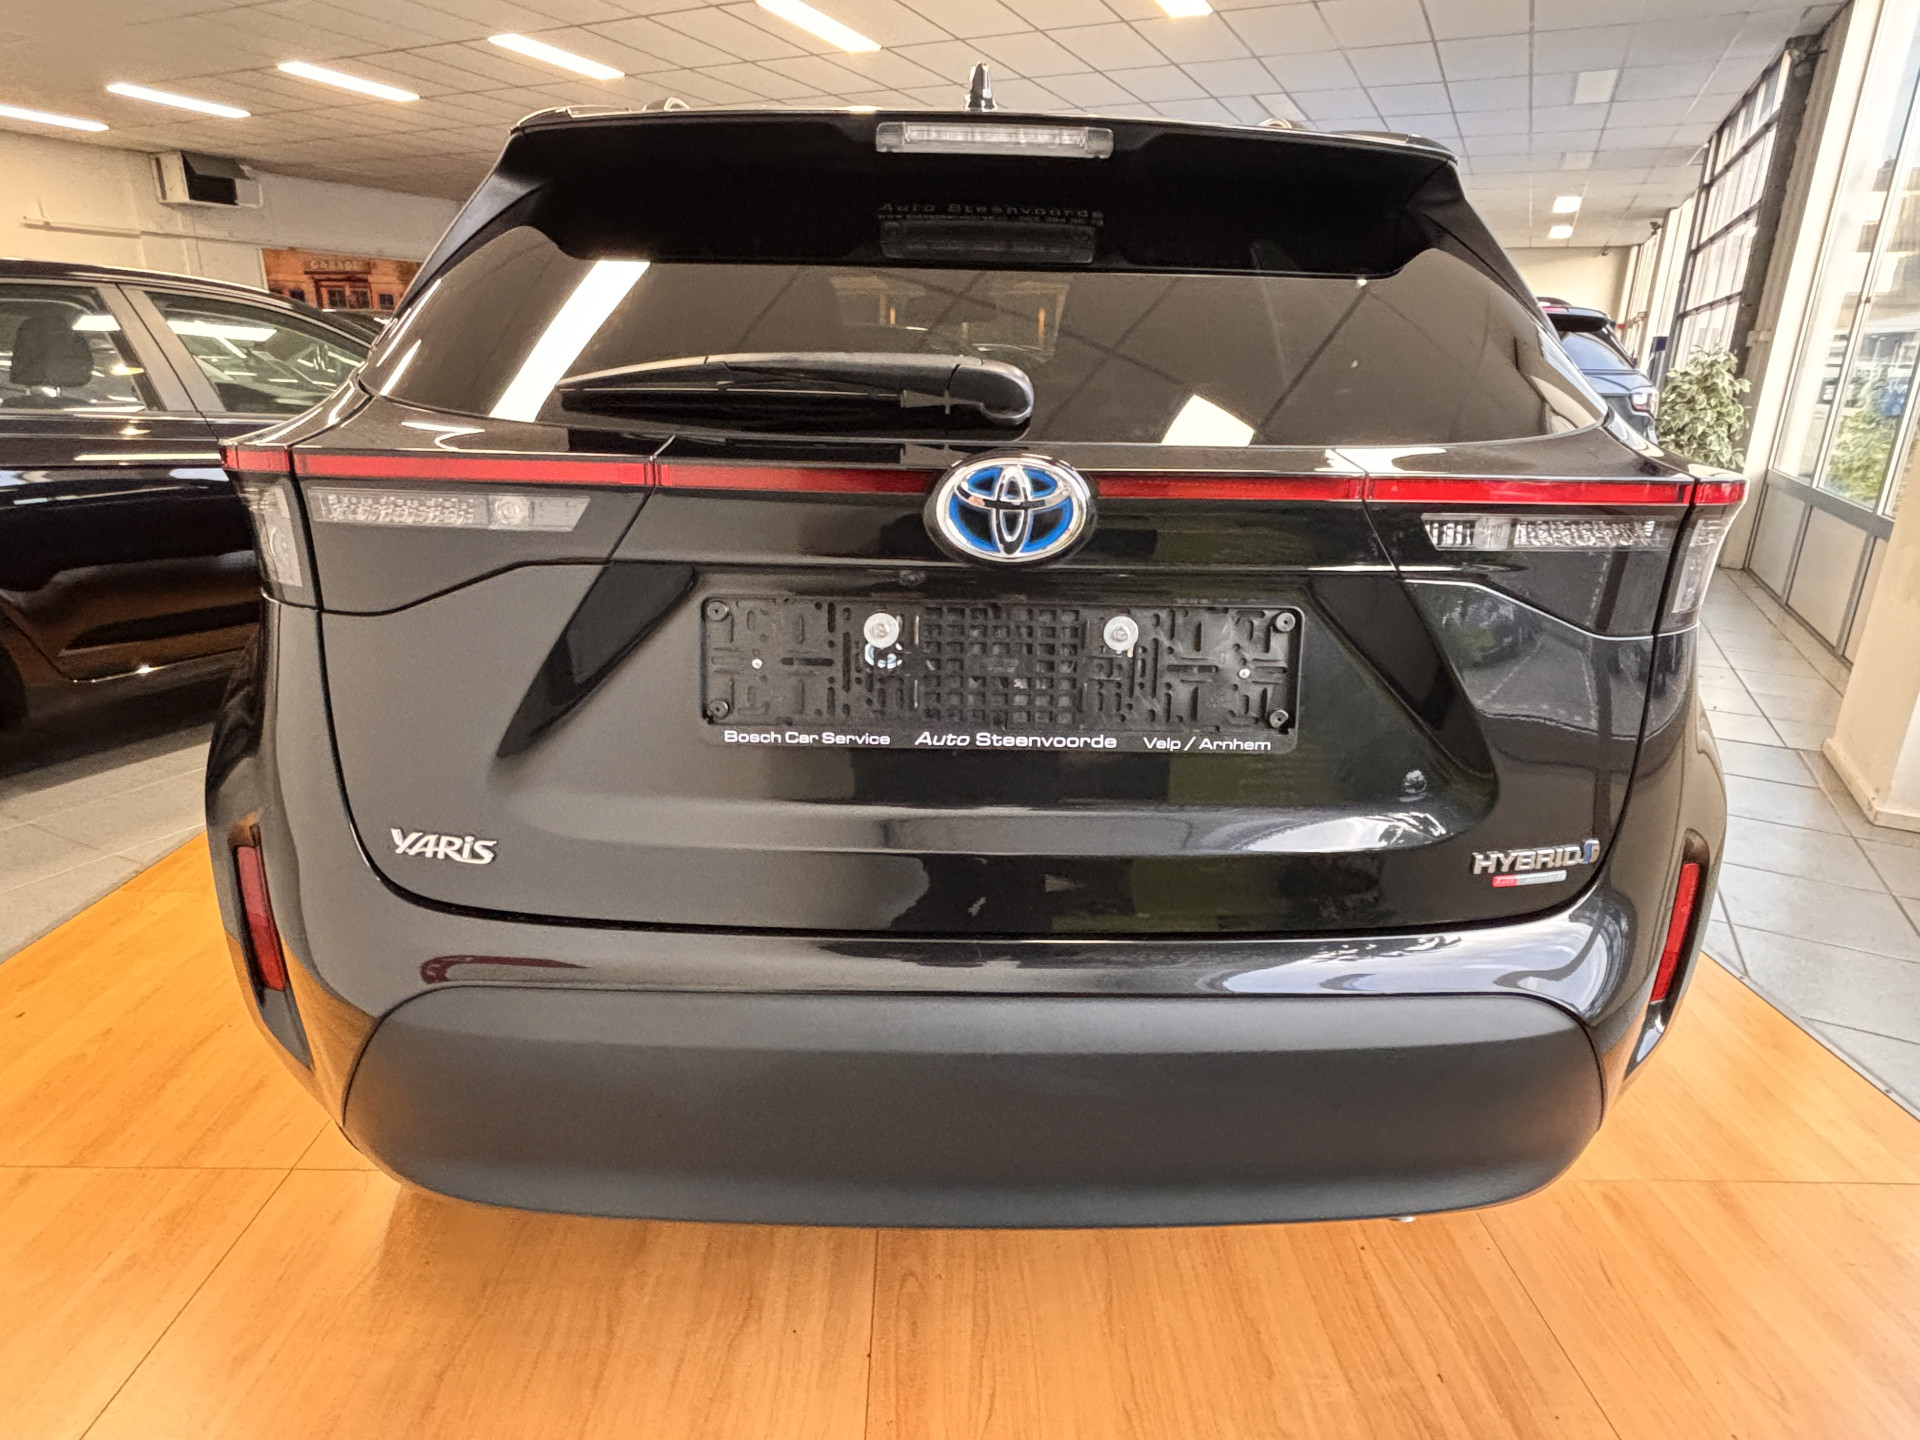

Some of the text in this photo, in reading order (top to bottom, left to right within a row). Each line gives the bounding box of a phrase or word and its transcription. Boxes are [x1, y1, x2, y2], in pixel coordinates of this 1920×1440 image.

[724, 730, 781, 743] Bosch
[785, 732, 818, 744] Car
[822, 732, 891, 745] Service
[914, 731, 970, 746] Auto
[975, 732, 1117, 748] Steenvoorde
[1143, 737, 1181, 751] Velp
[1199, 738, 1271, 751] Arnhem
[1472, 845, 1583, 874] HYBRID
